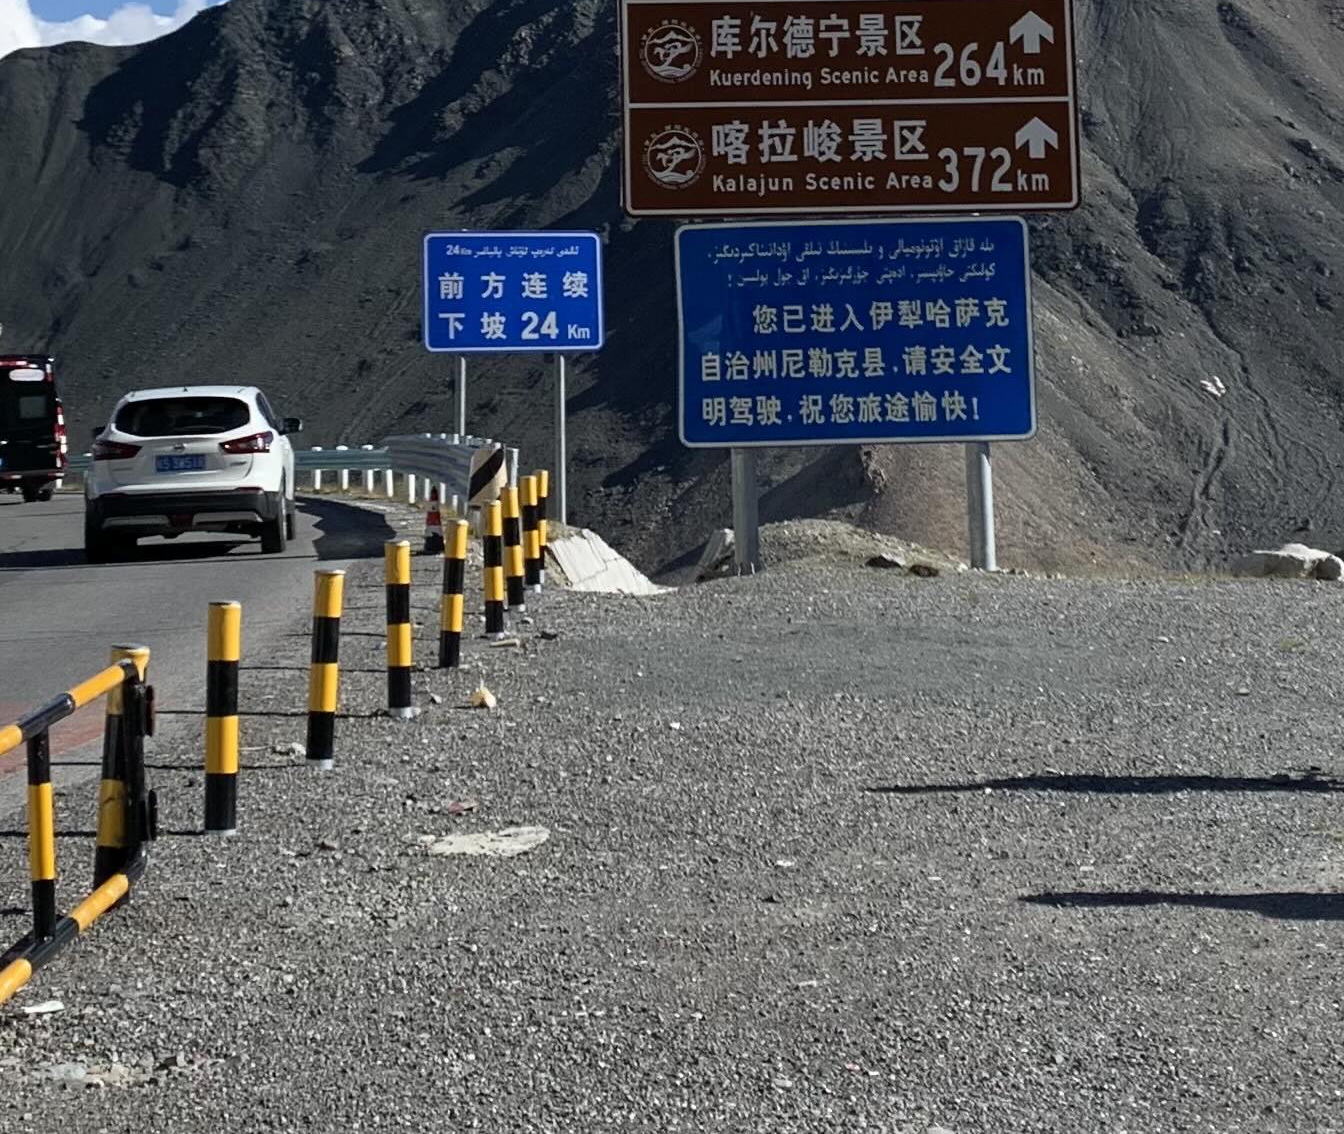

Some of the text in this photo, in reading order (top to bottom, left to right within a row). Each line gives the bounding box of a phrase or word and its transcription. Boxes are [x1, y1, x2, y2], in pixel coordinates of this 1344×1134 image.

[709, 12, 927, 59] 库尔德宁景区
[709, 66, 929, 90] Kuerdening Scenic Area
[711, 118, 930, 165] 喀拉峻景区
[712, 170, 934, 197] Kalajun Scenic Area
[437, 270, 590, 300] 前方连续
[752, 296, 1011, 334] 您已进入伊犁哈萨克
[567, 323, 592, 339] Km
